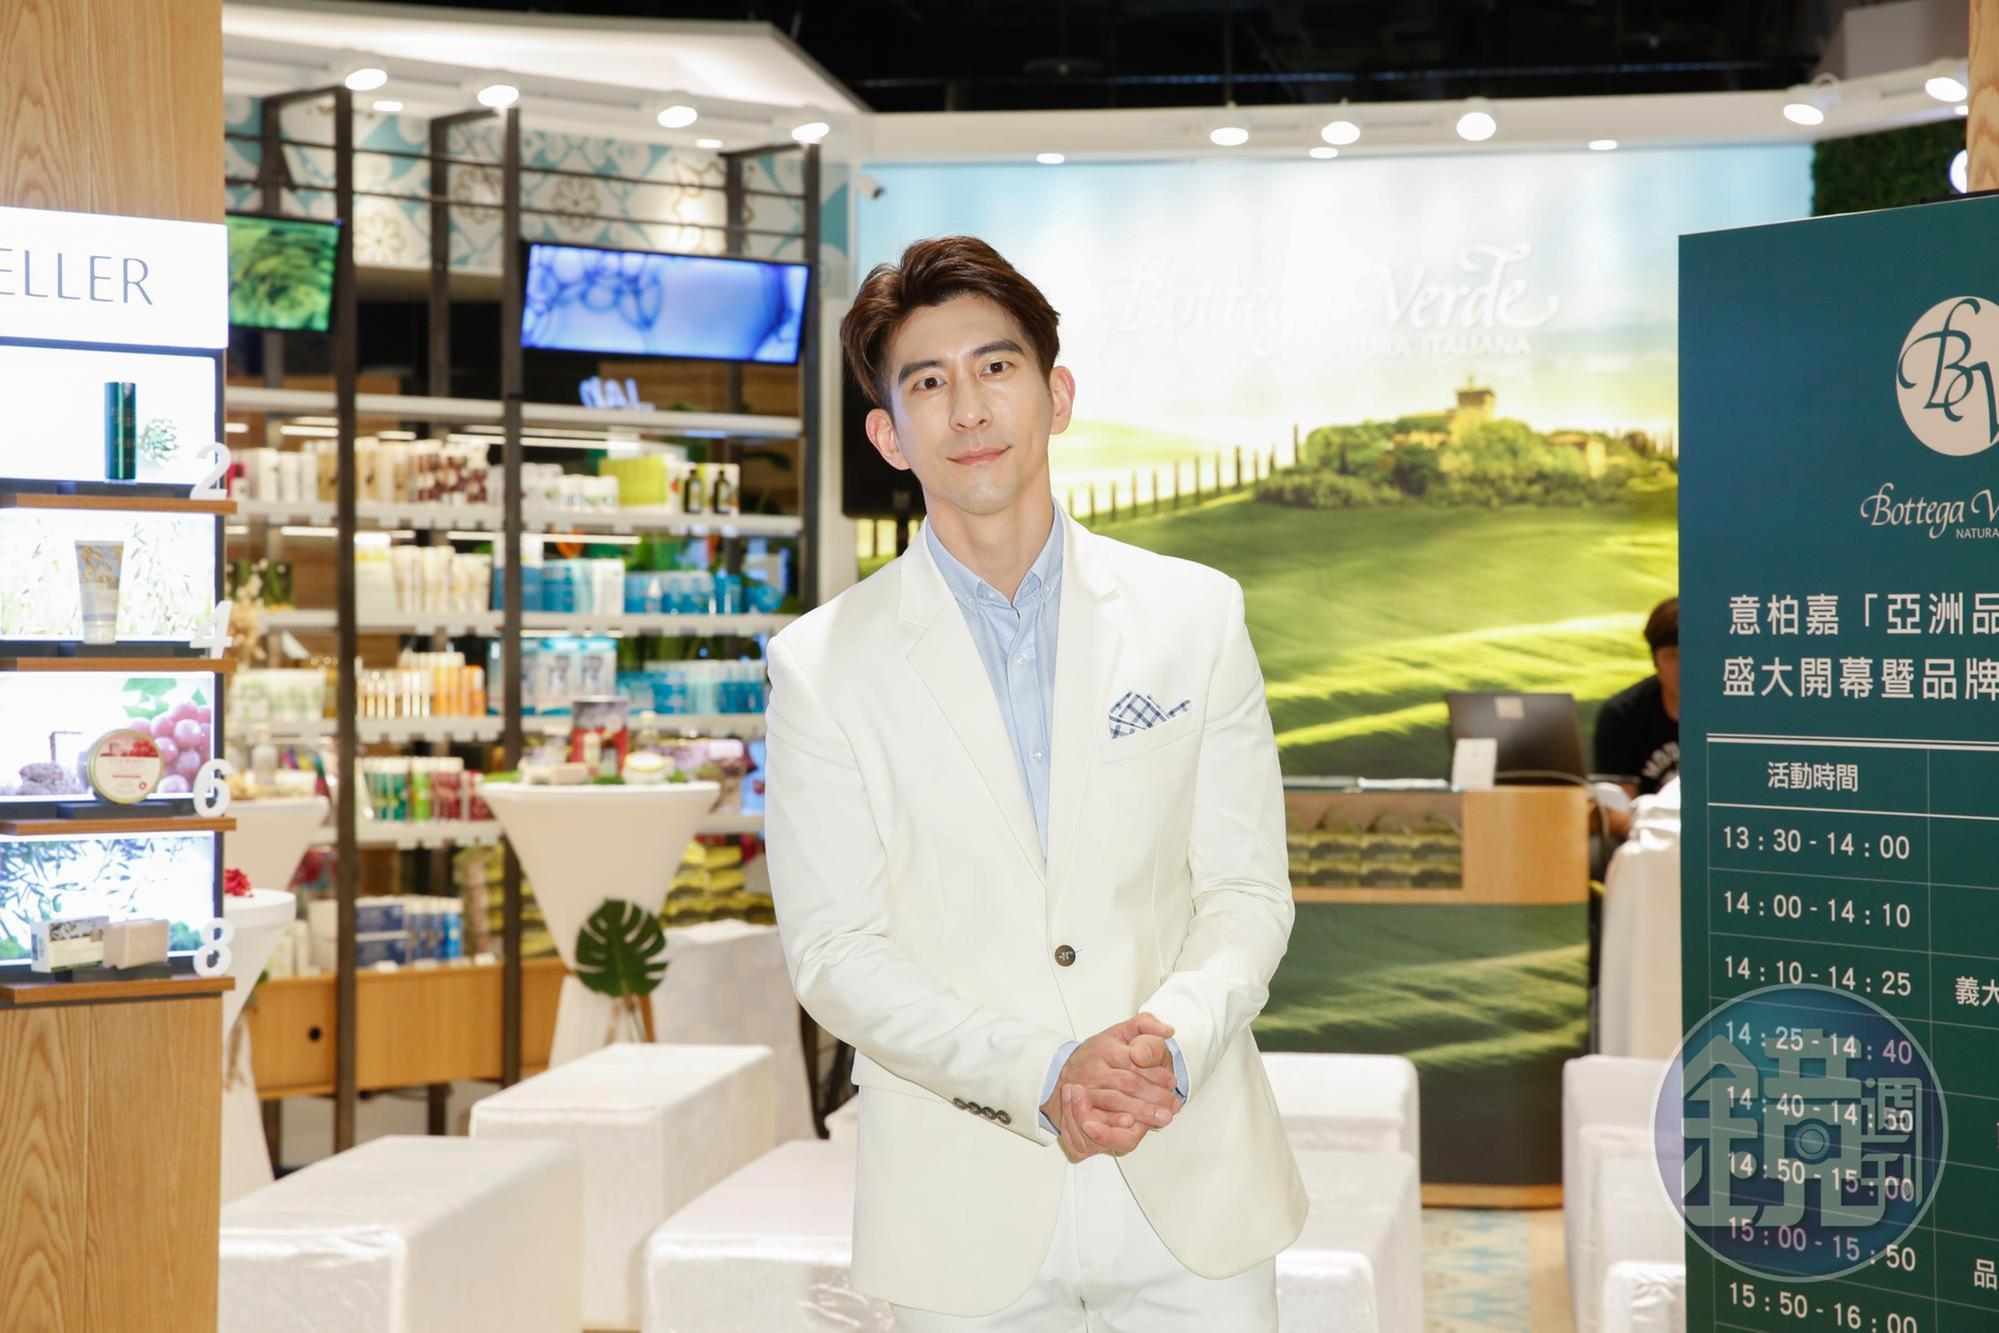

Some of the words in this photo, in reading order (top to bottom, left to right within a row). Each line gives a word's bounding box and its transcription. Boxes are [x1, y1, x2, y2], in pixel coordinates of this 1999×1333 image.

[1095, 249, 1334, 360] Botteg
[1352, 241, 1561, 330] Verde
[190, 442, 231, 500] 2
[1860, 483, 1965, 540] Bottega
[190, 600, 234, 659] 4
[1722, 656, 1999, 701] 盛大開幕暨品牌
[193, 759, 233, 818] 6
[1767, 761, 1859, 792] 活動時間
[193, 917, 235, 977] 8
[1955, 976, 1999, 1007] 義大
[1974, 1258, 1998, 1290] 品
